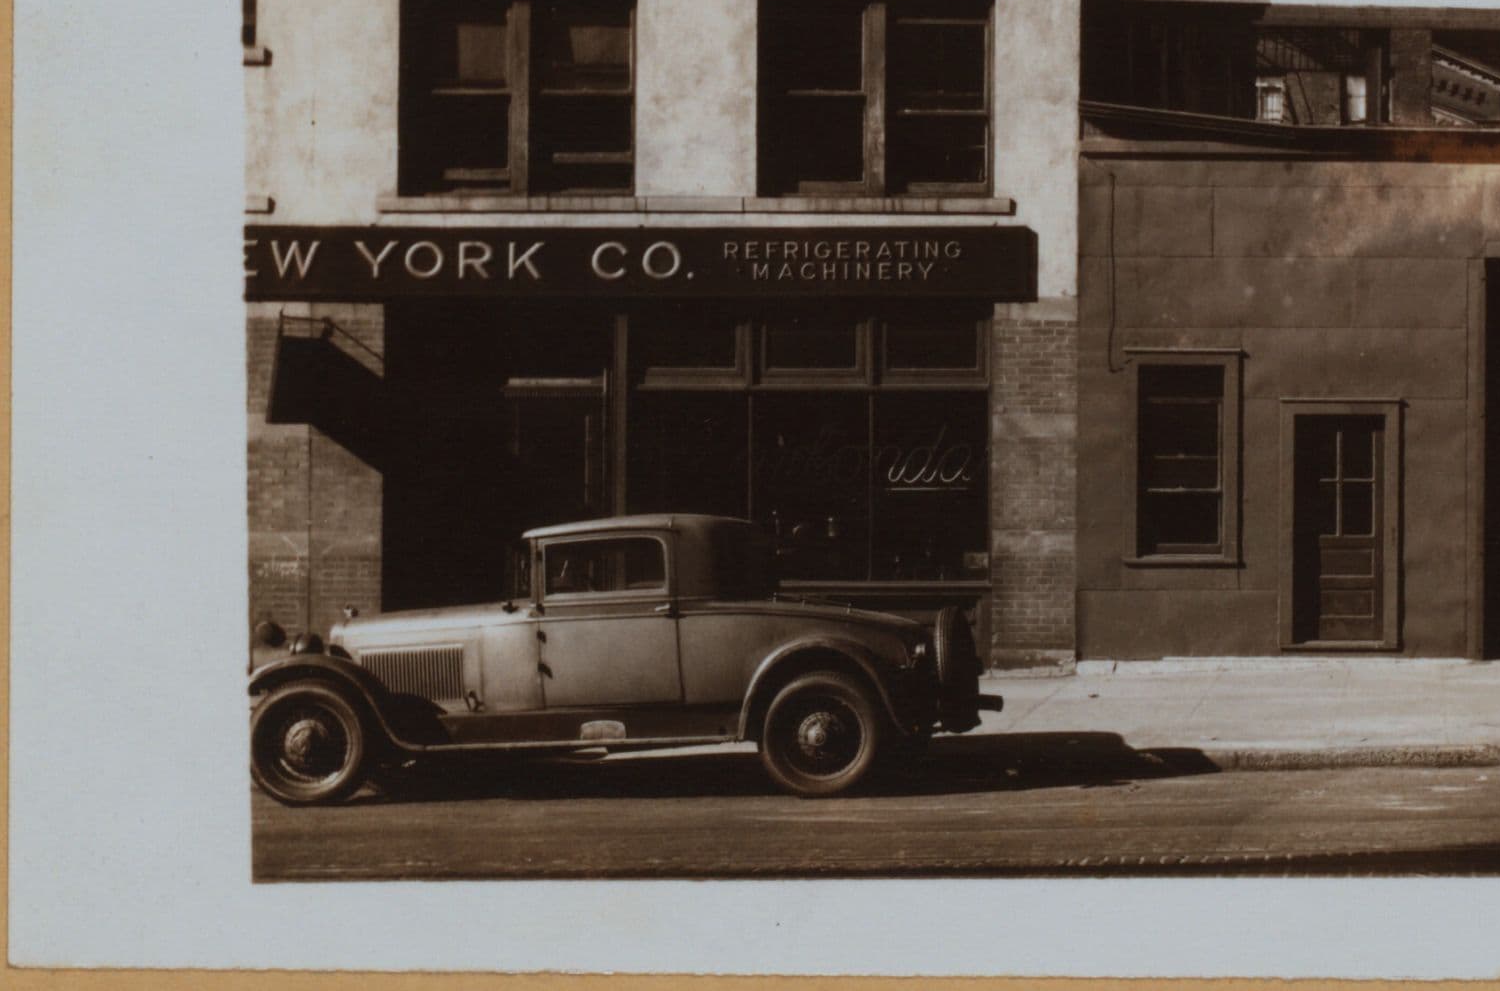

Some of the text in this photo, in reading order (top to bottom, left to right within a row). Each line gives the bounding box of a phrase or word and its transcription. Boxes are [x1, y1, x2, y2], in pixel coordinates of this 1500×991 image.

[354, 240, 544, 279] YORK
[591, 241, 694, 280] CO.
[723, 241, 963, 260] REFRIGERATING
[752, 262, 935, 281] MACHINERY
